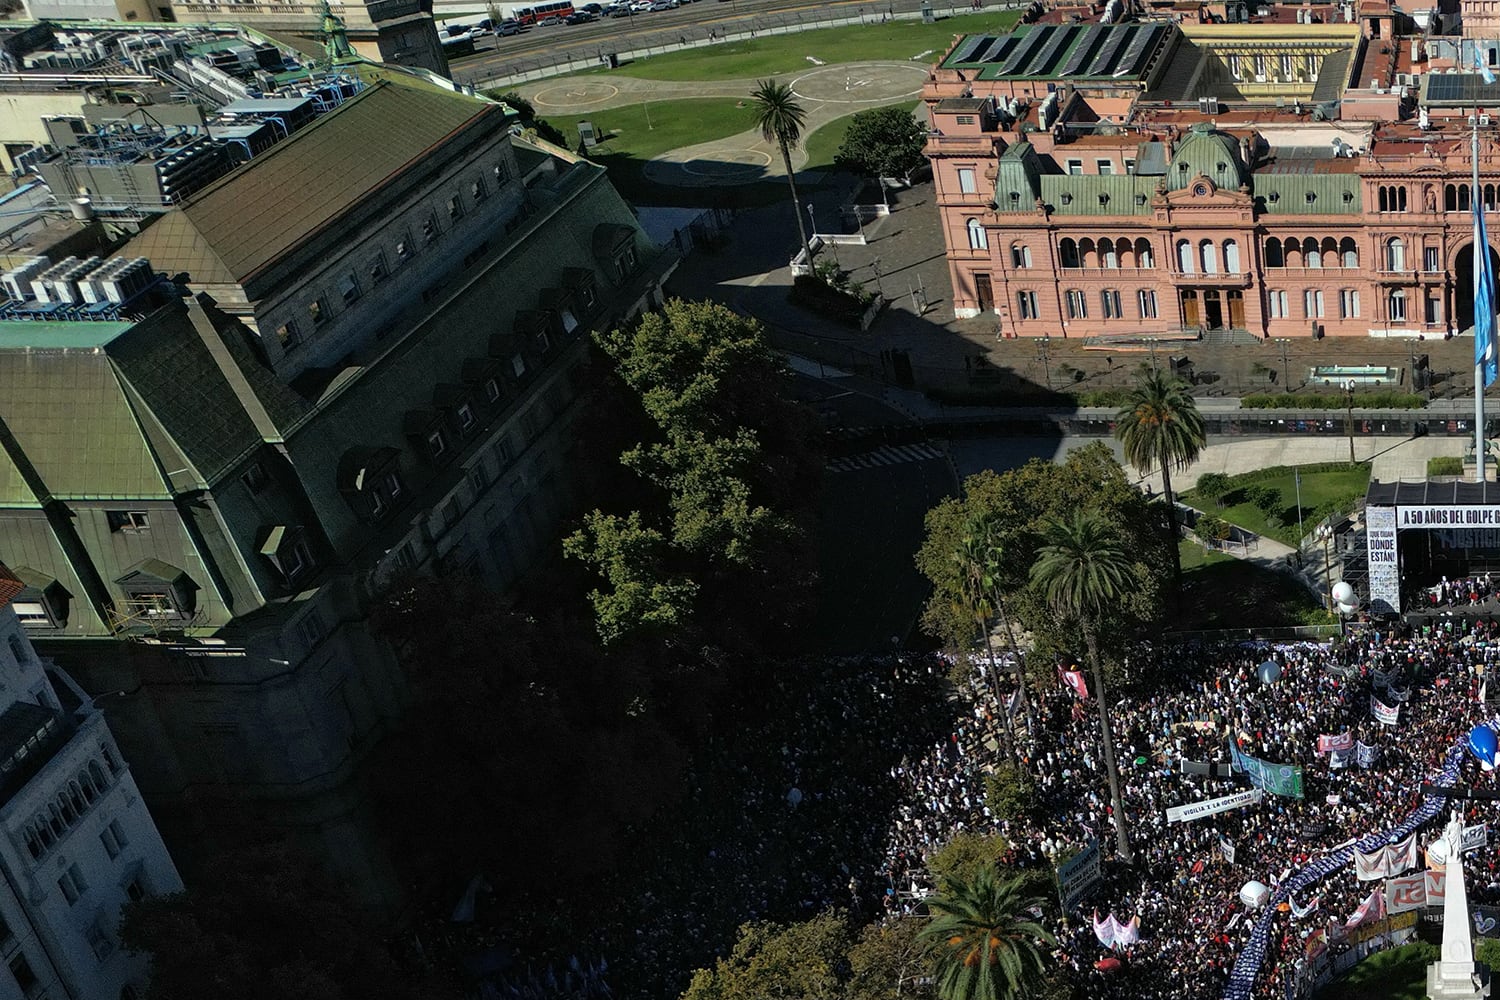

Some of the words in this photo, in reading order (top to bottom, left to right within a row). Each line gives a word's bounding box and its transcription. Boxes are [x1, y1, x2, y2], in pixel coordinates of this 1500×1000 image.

[1404, 511, 1410, 524] A
[1411, 510, 1422, 524] 50
[1424, 508, 1448, 524] AÑOS
[1450, 510, 1464, 524] DEL
[1466, 510, 1492, 524] GOLPE
[1370, 538, 1394, 550] DÓNDE
[1183, 806, 1205, 816] VIGILIA
[1221, 794, 1251, 806] IDENTIDAD
